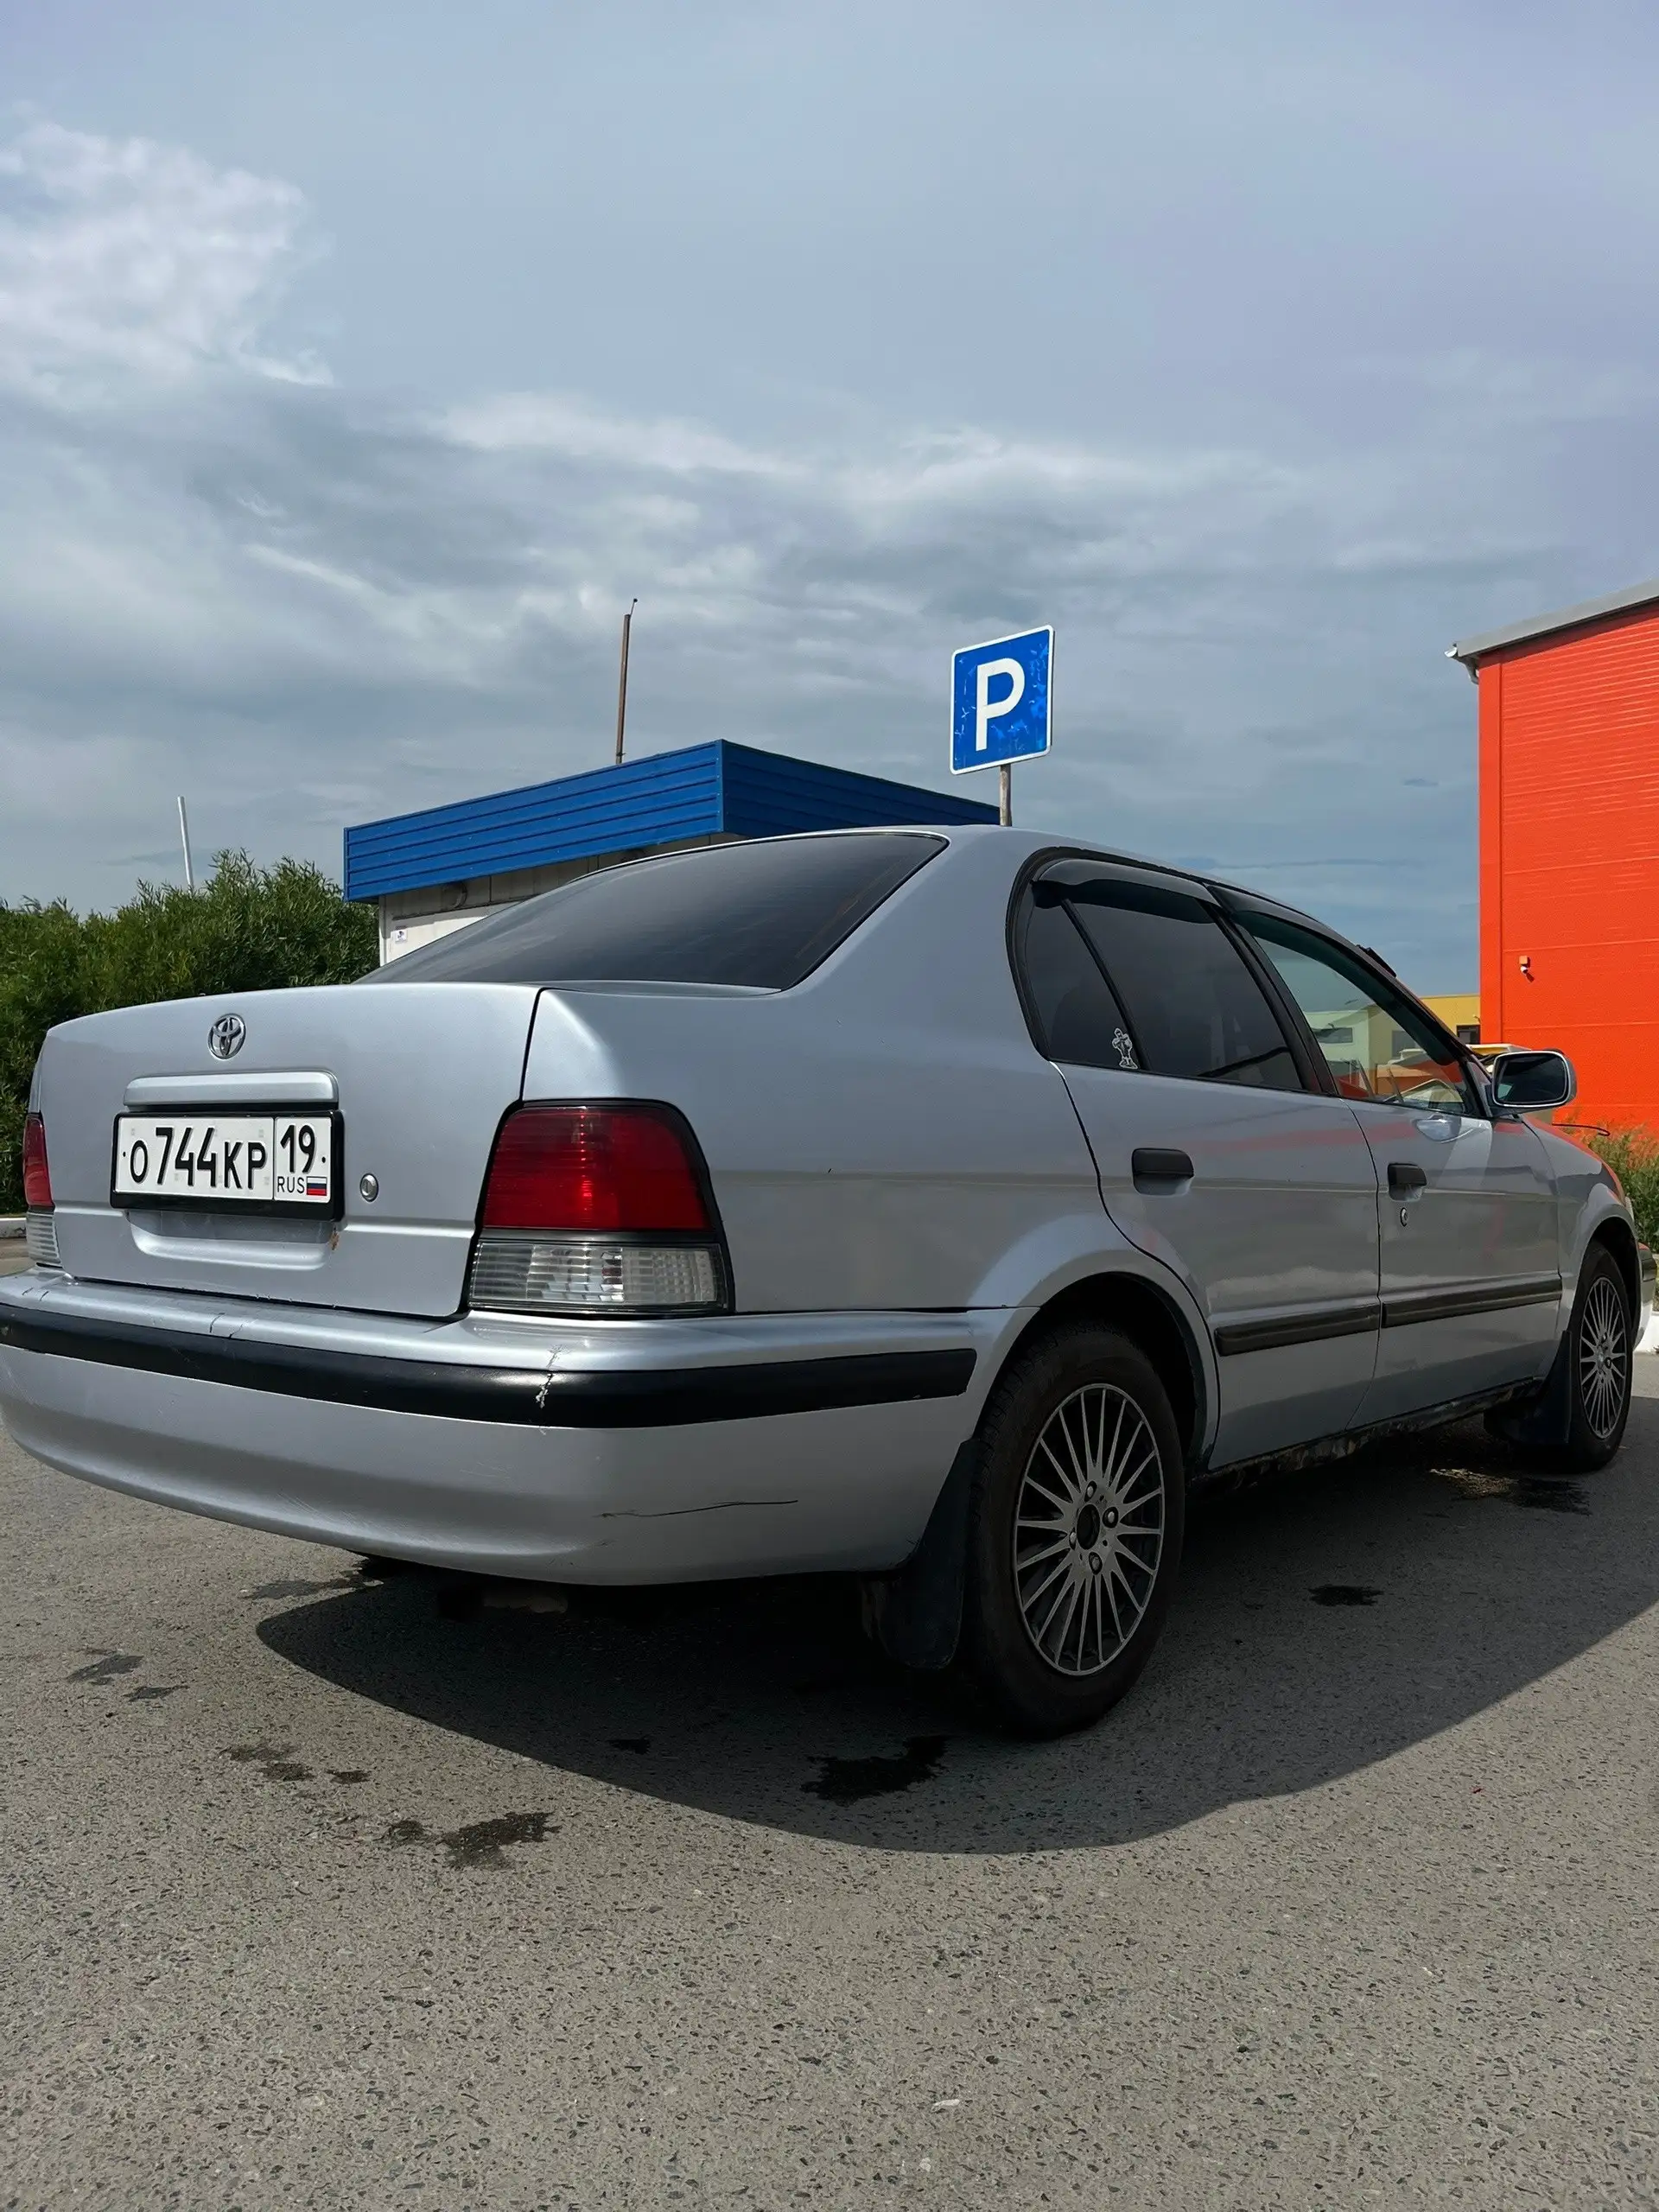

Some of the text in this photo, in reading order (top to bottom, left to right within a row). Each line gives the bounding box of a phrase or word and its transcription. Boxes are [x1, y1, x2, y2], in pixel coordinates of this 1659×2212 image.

[976, 658, 1026, 752] P
[279, 1124, 315, 1173] 19
[276, 1176, 305, 1194] RUS
